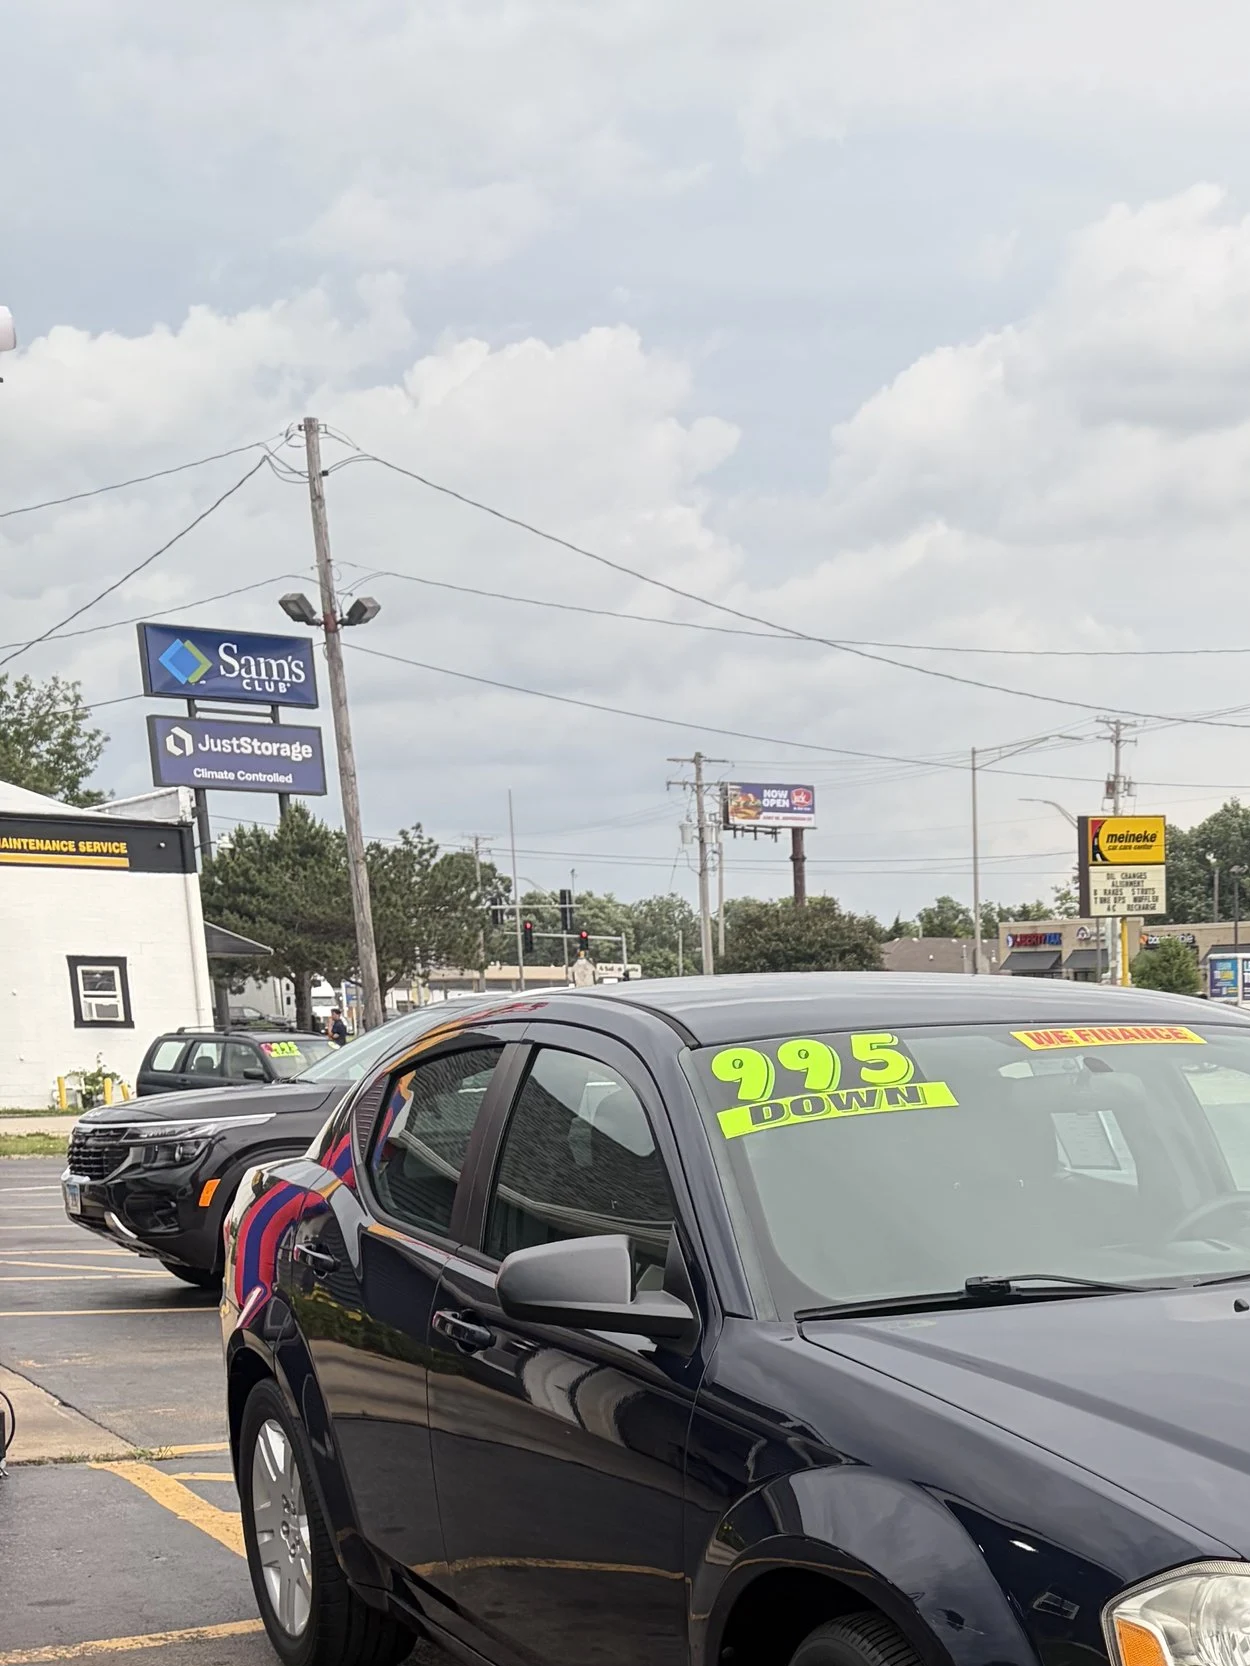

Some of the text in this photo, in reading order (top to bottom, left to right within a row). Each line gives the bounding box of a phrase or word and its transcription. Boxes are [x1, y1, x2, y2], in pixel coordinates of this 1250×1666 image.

[218, 642, 306, 683] Sam's
[242, 679, 288, 693] CLUB
[198, 734, 313, 761] JustStorage
[193, 767, 293, 784] Climate Controlled
[763, 789, 789, 799] NOW
[762, 798, 790, 808] OPEN
[1106, 830, 1157, 843] meineke
[78, 841, 128, 854] SERVICE
[1120, 872, 1147, 880] CHANGES
[1111, 880, 1145, 888] ALIGNMENT
[1131, 887, 1156, 895] STRUTS
[1133, 895, 1159, 903] MUFFLER
[1126, 903, 1157, 912] RECHARGE
[1024, 1027, 1190, 1046] WE FINANCE
[711, 1033, 915, 1101] 995
[749, 1085, 927, 1126] DOWN
